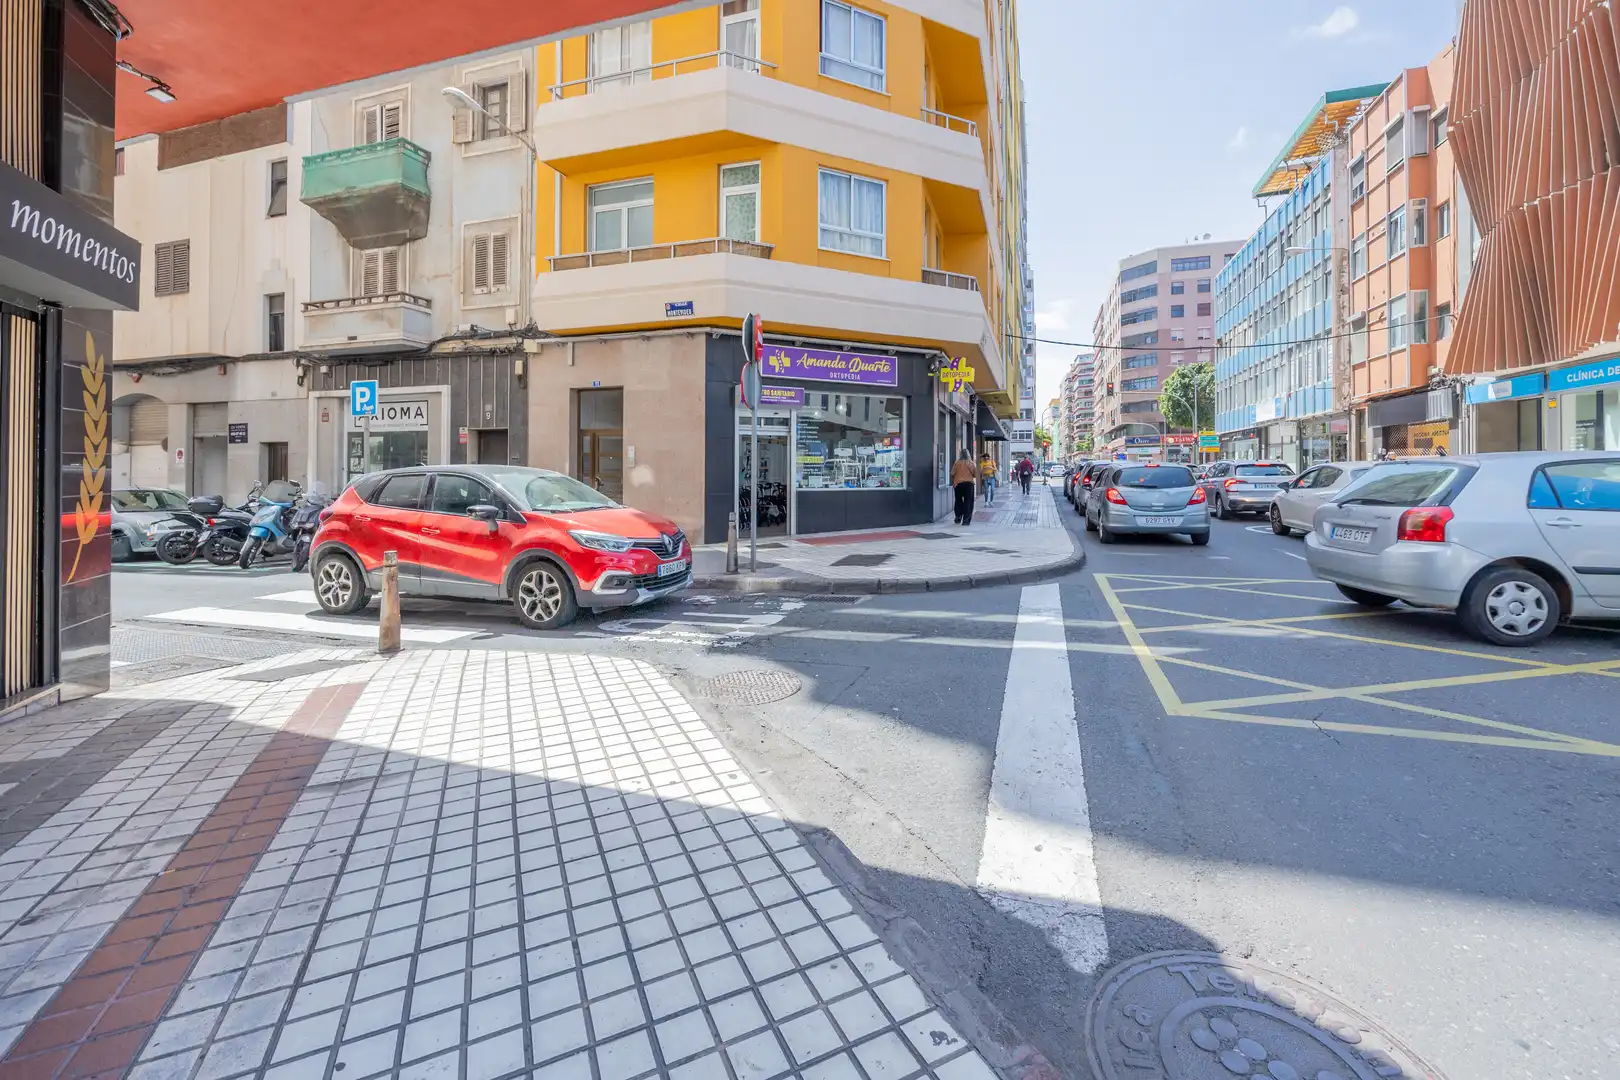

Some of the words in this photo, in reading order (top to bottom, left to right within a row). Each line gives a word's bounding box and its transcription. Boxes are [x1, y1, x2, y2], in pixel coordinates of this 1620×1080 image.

[11, 199, 136, 283] momentos
[796, 353, 847, 369] Amanda
[848, 357, 891, 373] Duarte
[829, 372, 861, 381] ORTOPEDIA
[1566, 369, 1604, 382] CLÍNICA
[355, 387, 371, 411] P
[771, 389, 795, 397] SANITARIO
[485, 411, 491, 420] 9
